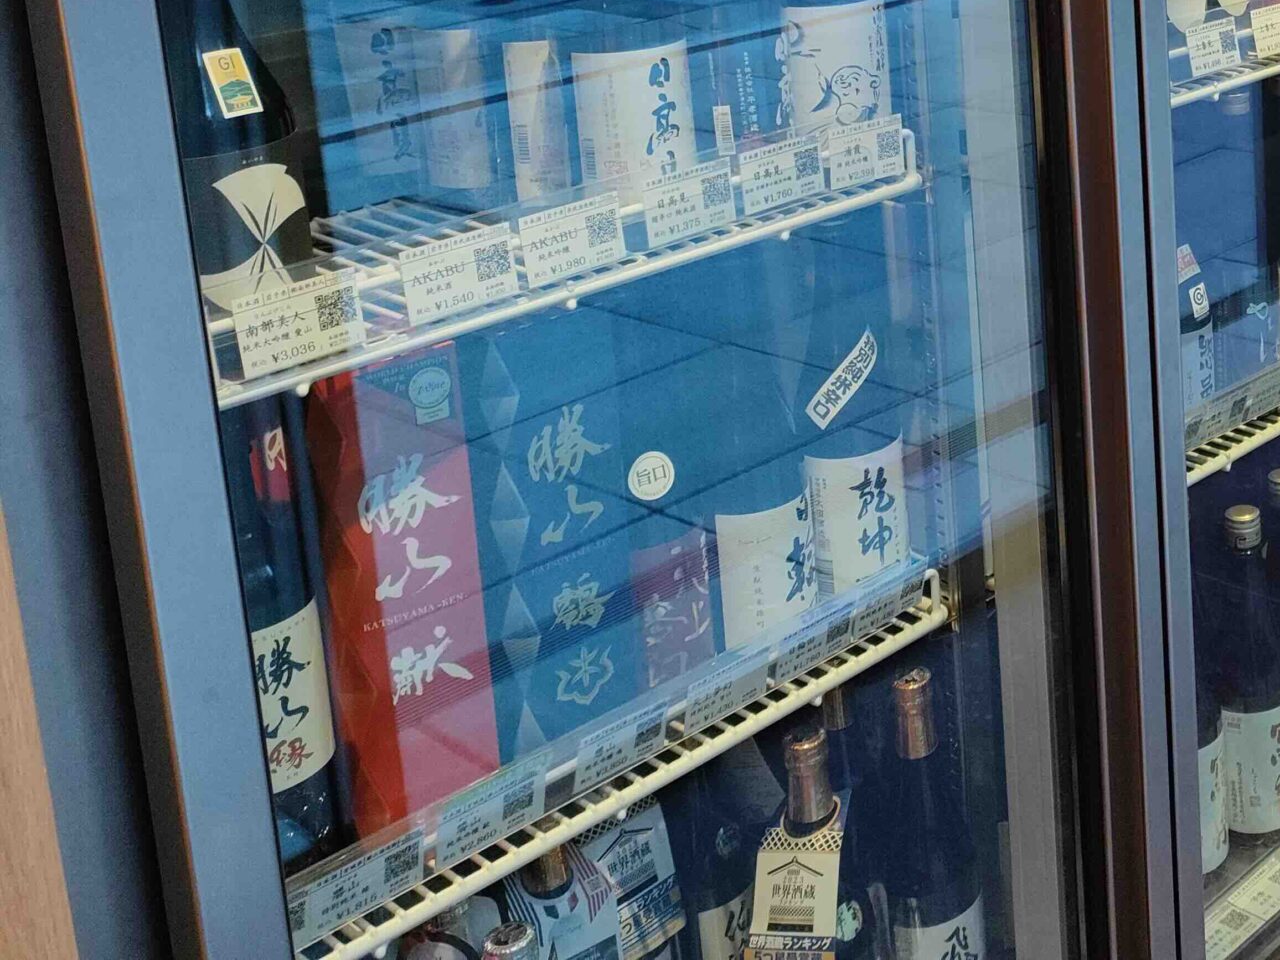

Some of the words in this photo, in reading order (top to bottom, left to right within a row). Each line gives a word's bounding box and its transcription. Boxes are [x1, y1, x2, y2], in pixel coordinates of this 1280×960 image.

[218, 56, 236, 71] GI
[753, 166, 784, 181] 日高見
[657, 192, 690, 209] 日高見
[764, 189, 793, 205] ¥1,760
[669, 217, 702, 235] ¥1,375
[529, 228, 579, 253] AKABU
[411, 261, 466, 289] AKABU
[550, 256, 587, 276] ¥1,980
[435, 291, 475, 311] ¥1,540
[245, 311, 306, 338] 南部美人
[272, 341, 317, 364] ¥3,036
[636, 463, 668, 487] 旨口
[363, 604, 435, 632] KATSUYAMA
